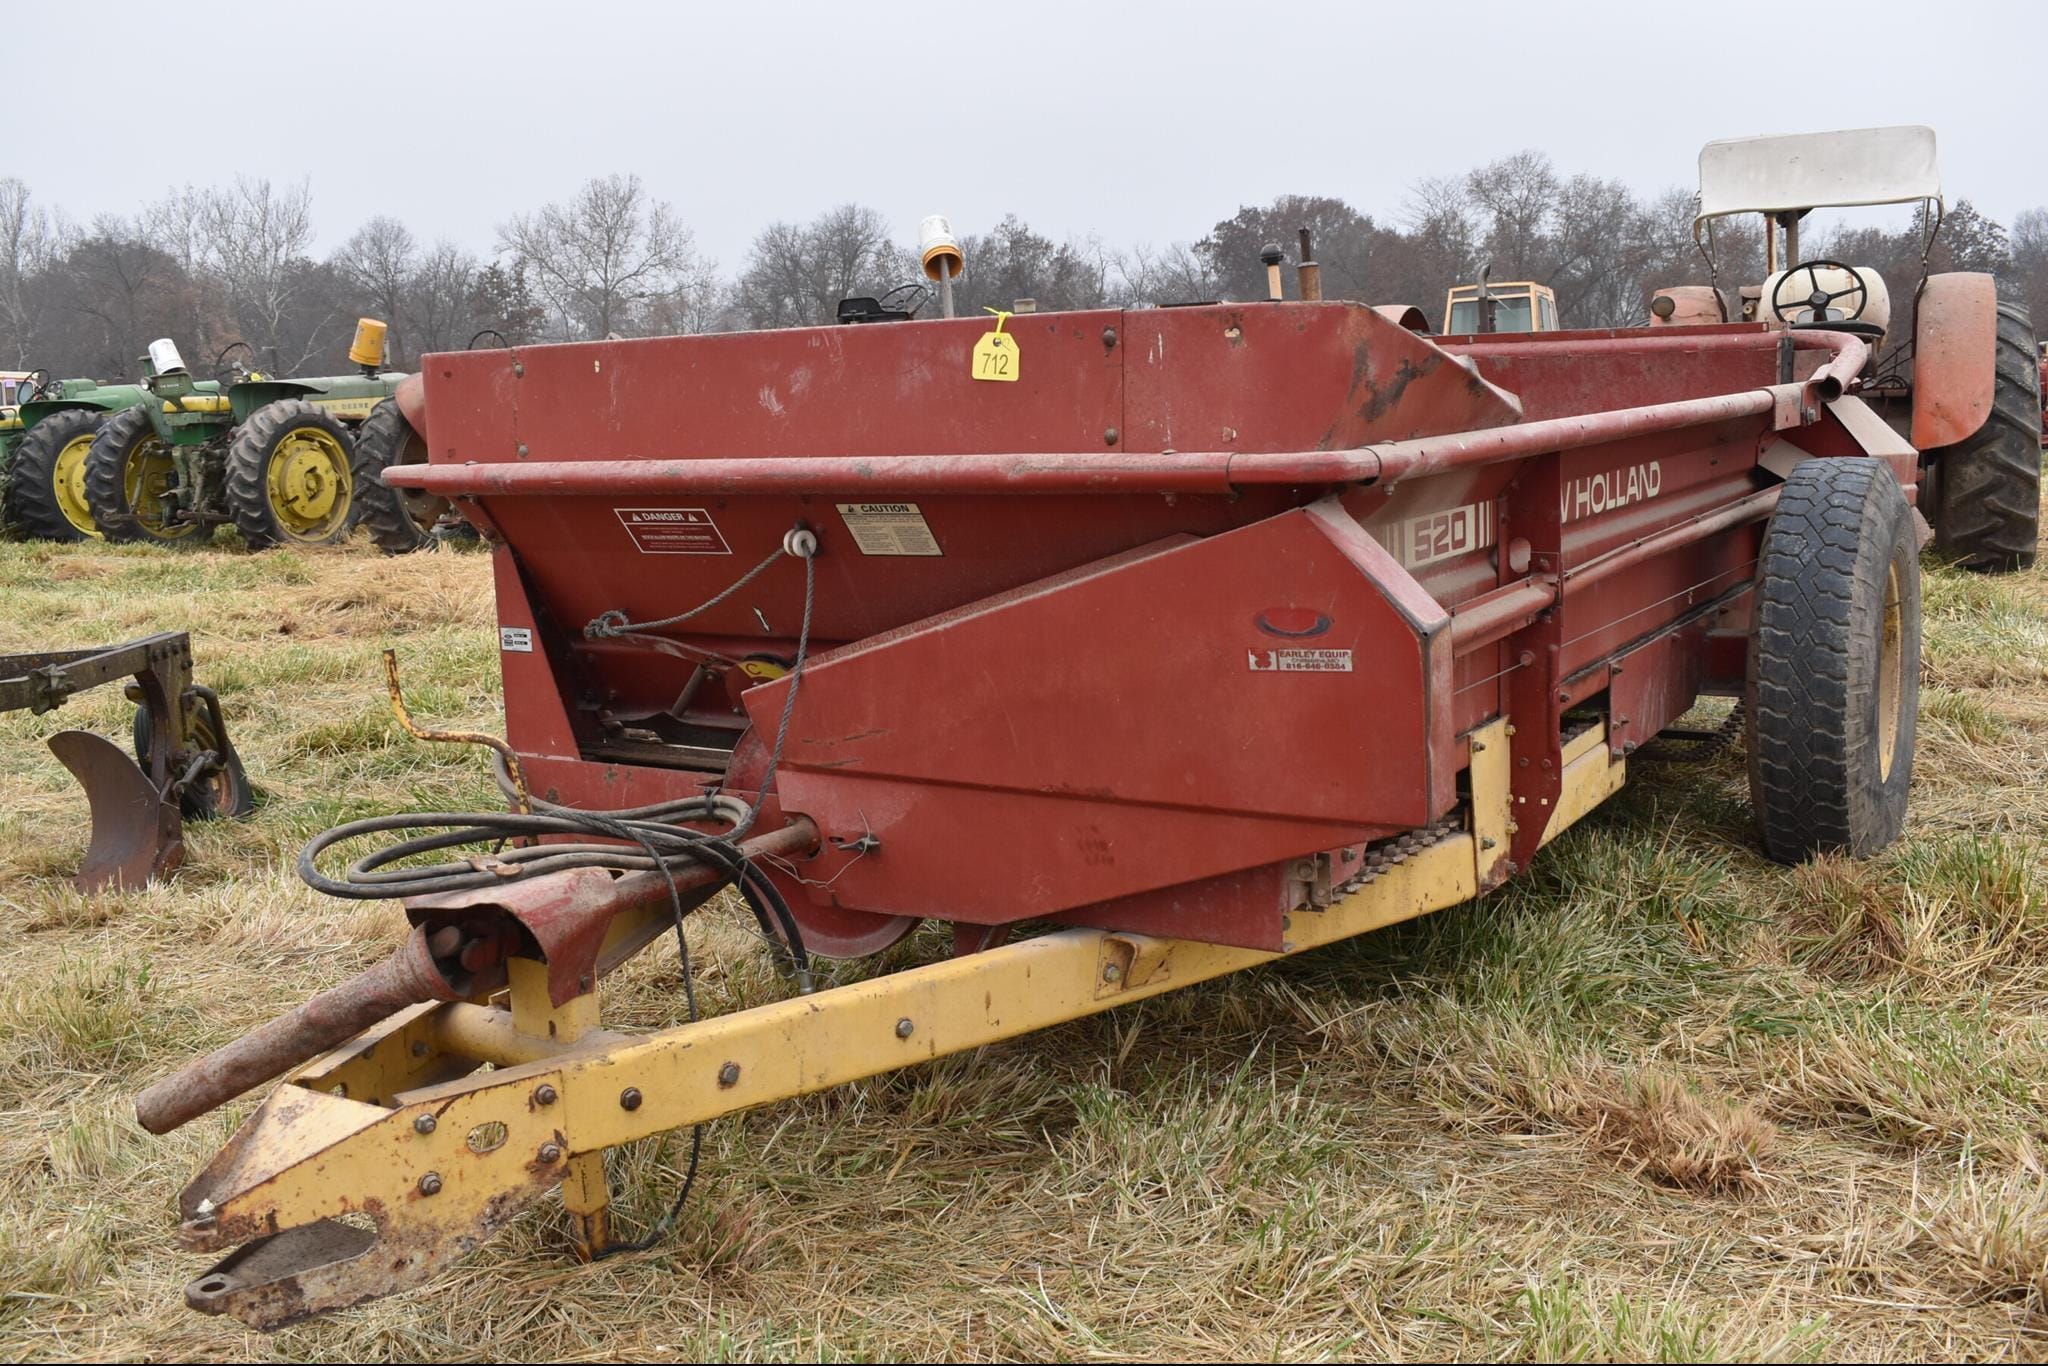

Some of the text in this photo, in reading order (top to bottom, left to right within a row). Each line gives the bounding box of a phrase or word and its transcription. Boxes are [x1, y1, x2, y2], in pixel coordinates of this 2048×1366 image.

[982, 353, 1009, 375] 712
[1575, 460, 1661, 520] HOLLAND
[641, 512, 685, 521] DANGER
[860, 504, 910, 513] CAUTION
[1414, 509, 1467, 562] 520
